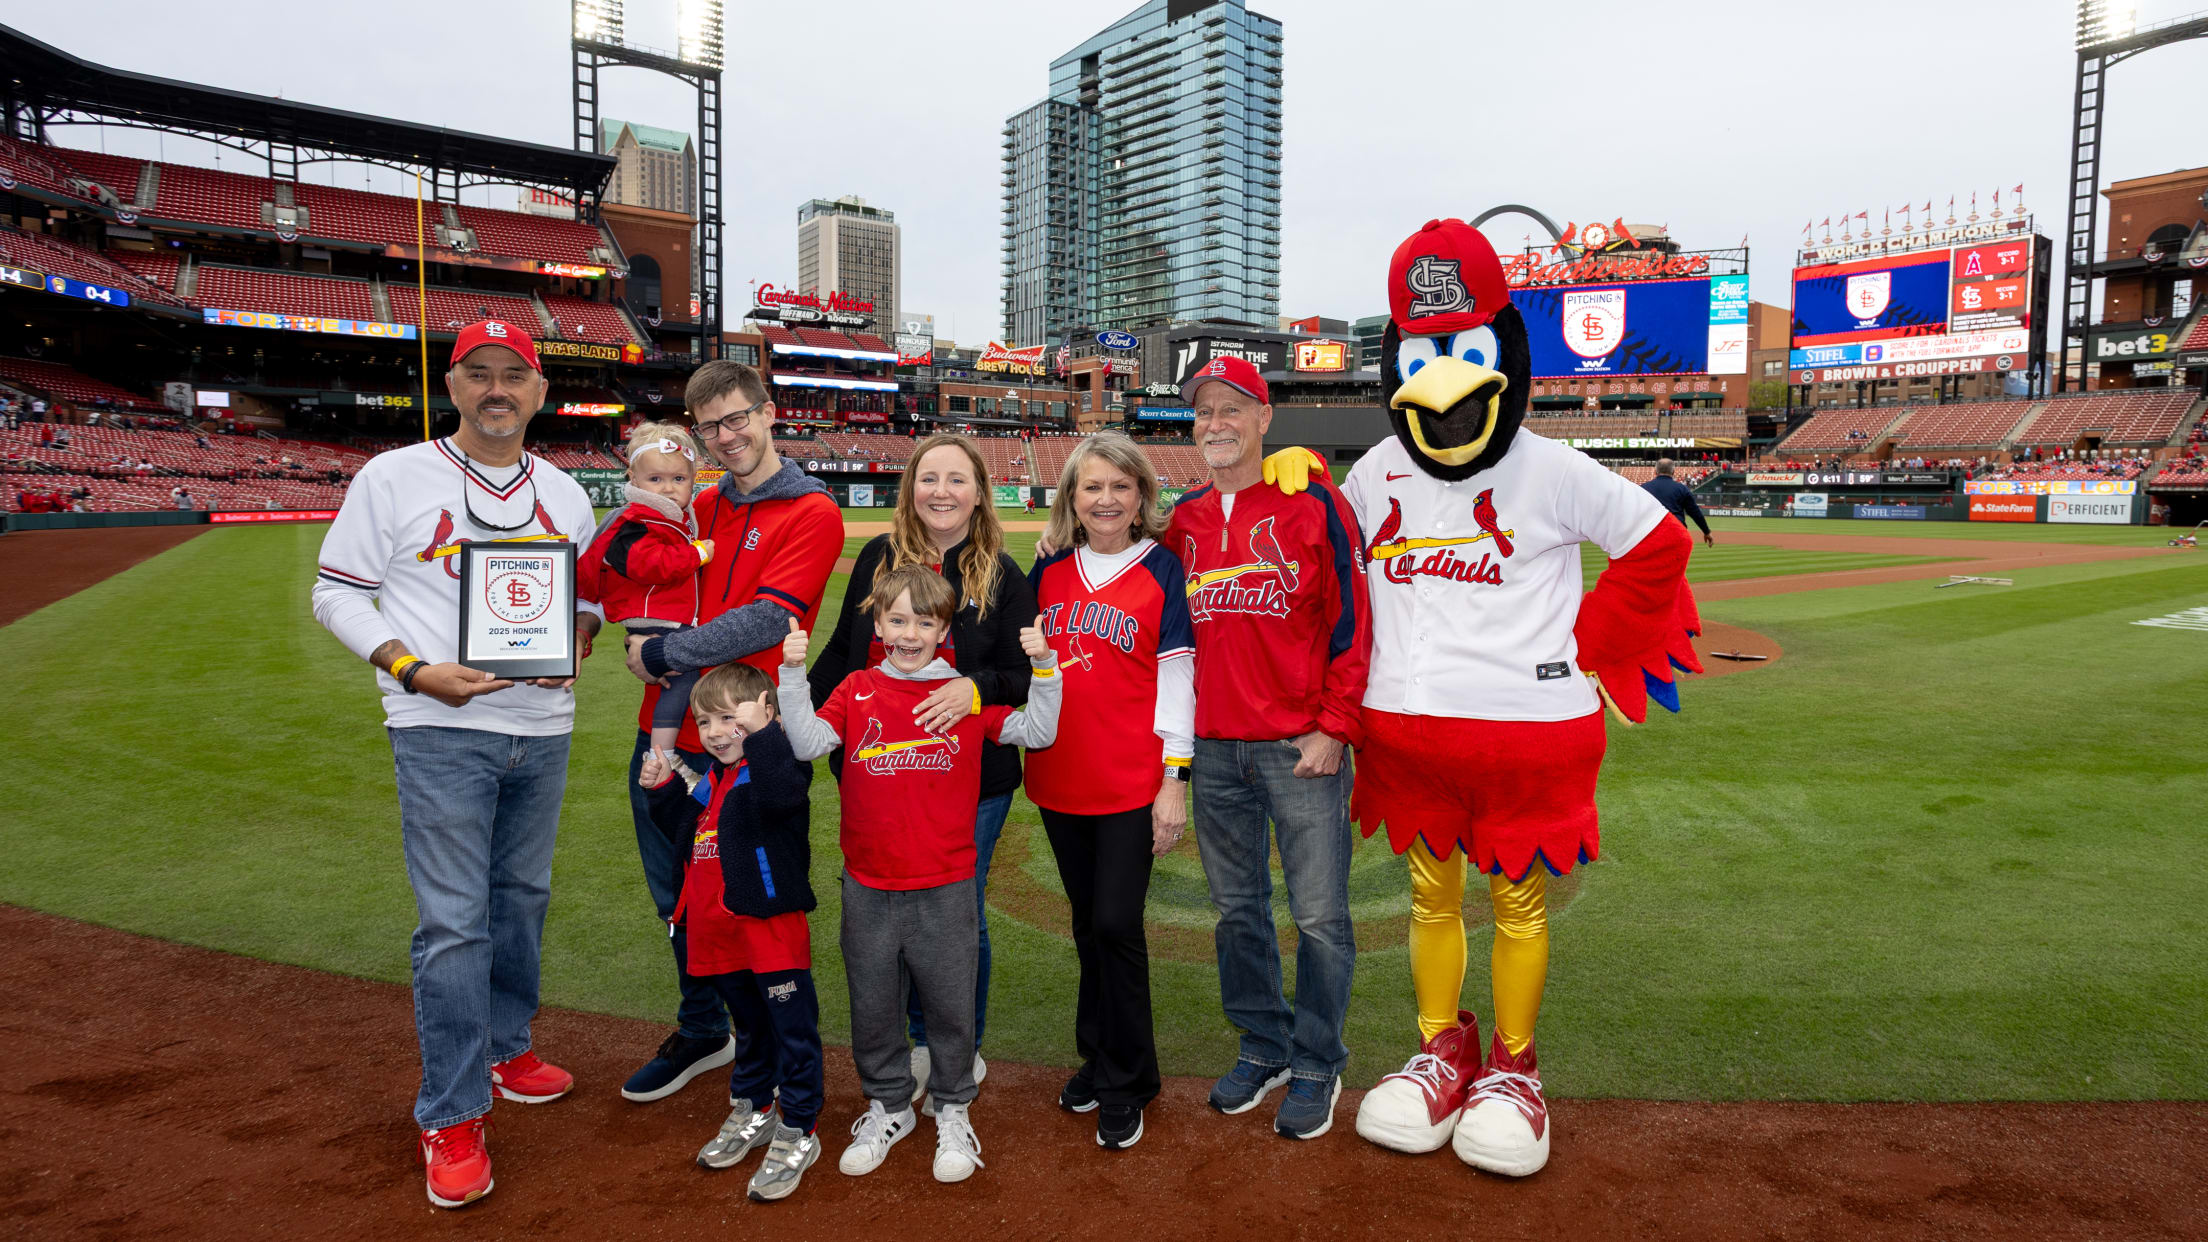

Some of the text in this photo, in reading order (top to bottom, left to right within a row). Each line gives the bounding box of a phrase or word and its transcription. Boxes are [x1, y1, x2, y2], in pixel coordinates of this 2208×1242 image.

[531, 187, 585, 210] Hilto
[1817, 221, 2009, 260] WORLD CHAMPIONS
[1499, 247, 1710, 288] Budweiser
[2001, 256, 2015, 265] 3-1
[86, 286, 111, 302] 0-4
[758, 283, 874, 313] Cardinals Nation
[1567, 293, 1613, 304] PITCHING
[1999, 292, 2013, 300] 3-1
[219, 310, 404, 337] FOR THE LOU
[827, 315, 864, 325] ROOFTOP
[896, 336, 931, 346] FANDUEL
[1105, 332, 1131, 347] Ford
[543, 342, 580, 357] MAC
[581, 345, 620, 360] LAND
[979, 345, 1045, 363] Budweiser
[1209, 349, 1268, 363] FROM THE
[1806, 348, 1846, 362] STIFEL
[976, 360, 1047, 376] BREW HOUSE
[1109, 364, 1133, 373] merica
[1823, 359, 1983, 381] BROWN & CROUPPEN
[2133, 362, 2174, 371] bet365
[1533, 385, 1544, 396] 10
[1551, 384, 1562, 395] 14
[1569, 384, 1580, 395] 17
[1609, 383, 1624, 394] 23
[1630, 383, 1645, 393] 24
[1651, 382, 1667, 393] 42
[1673, 382, 1689, 393] 45
[355, 393, 412, 407] bet365
[1573, 438, 1623, 448] BUSCH
[1628, 438, 1695, 448] STADIUM
[1752, 473, 1799, 481] Schnucks
[1822, 475, 1840, 483] 6:11
[1965, 481, 2135, 494] FOR THE LOU
[1860, 507, 1889, 517] STIFEL
[2051, 501, 2127, 516] PERFICIENT
[490, 560, 549, 570] PITCHING IN
[1384, 548, 1504, 586] Cardinals
[489, 627, 548, 635] 2025 HONOREE
[1067, 600, 1139, 653] LOUIS
[865, 747, 954, 776] Cardinals
[768, 980, 797, 999] PUMA
